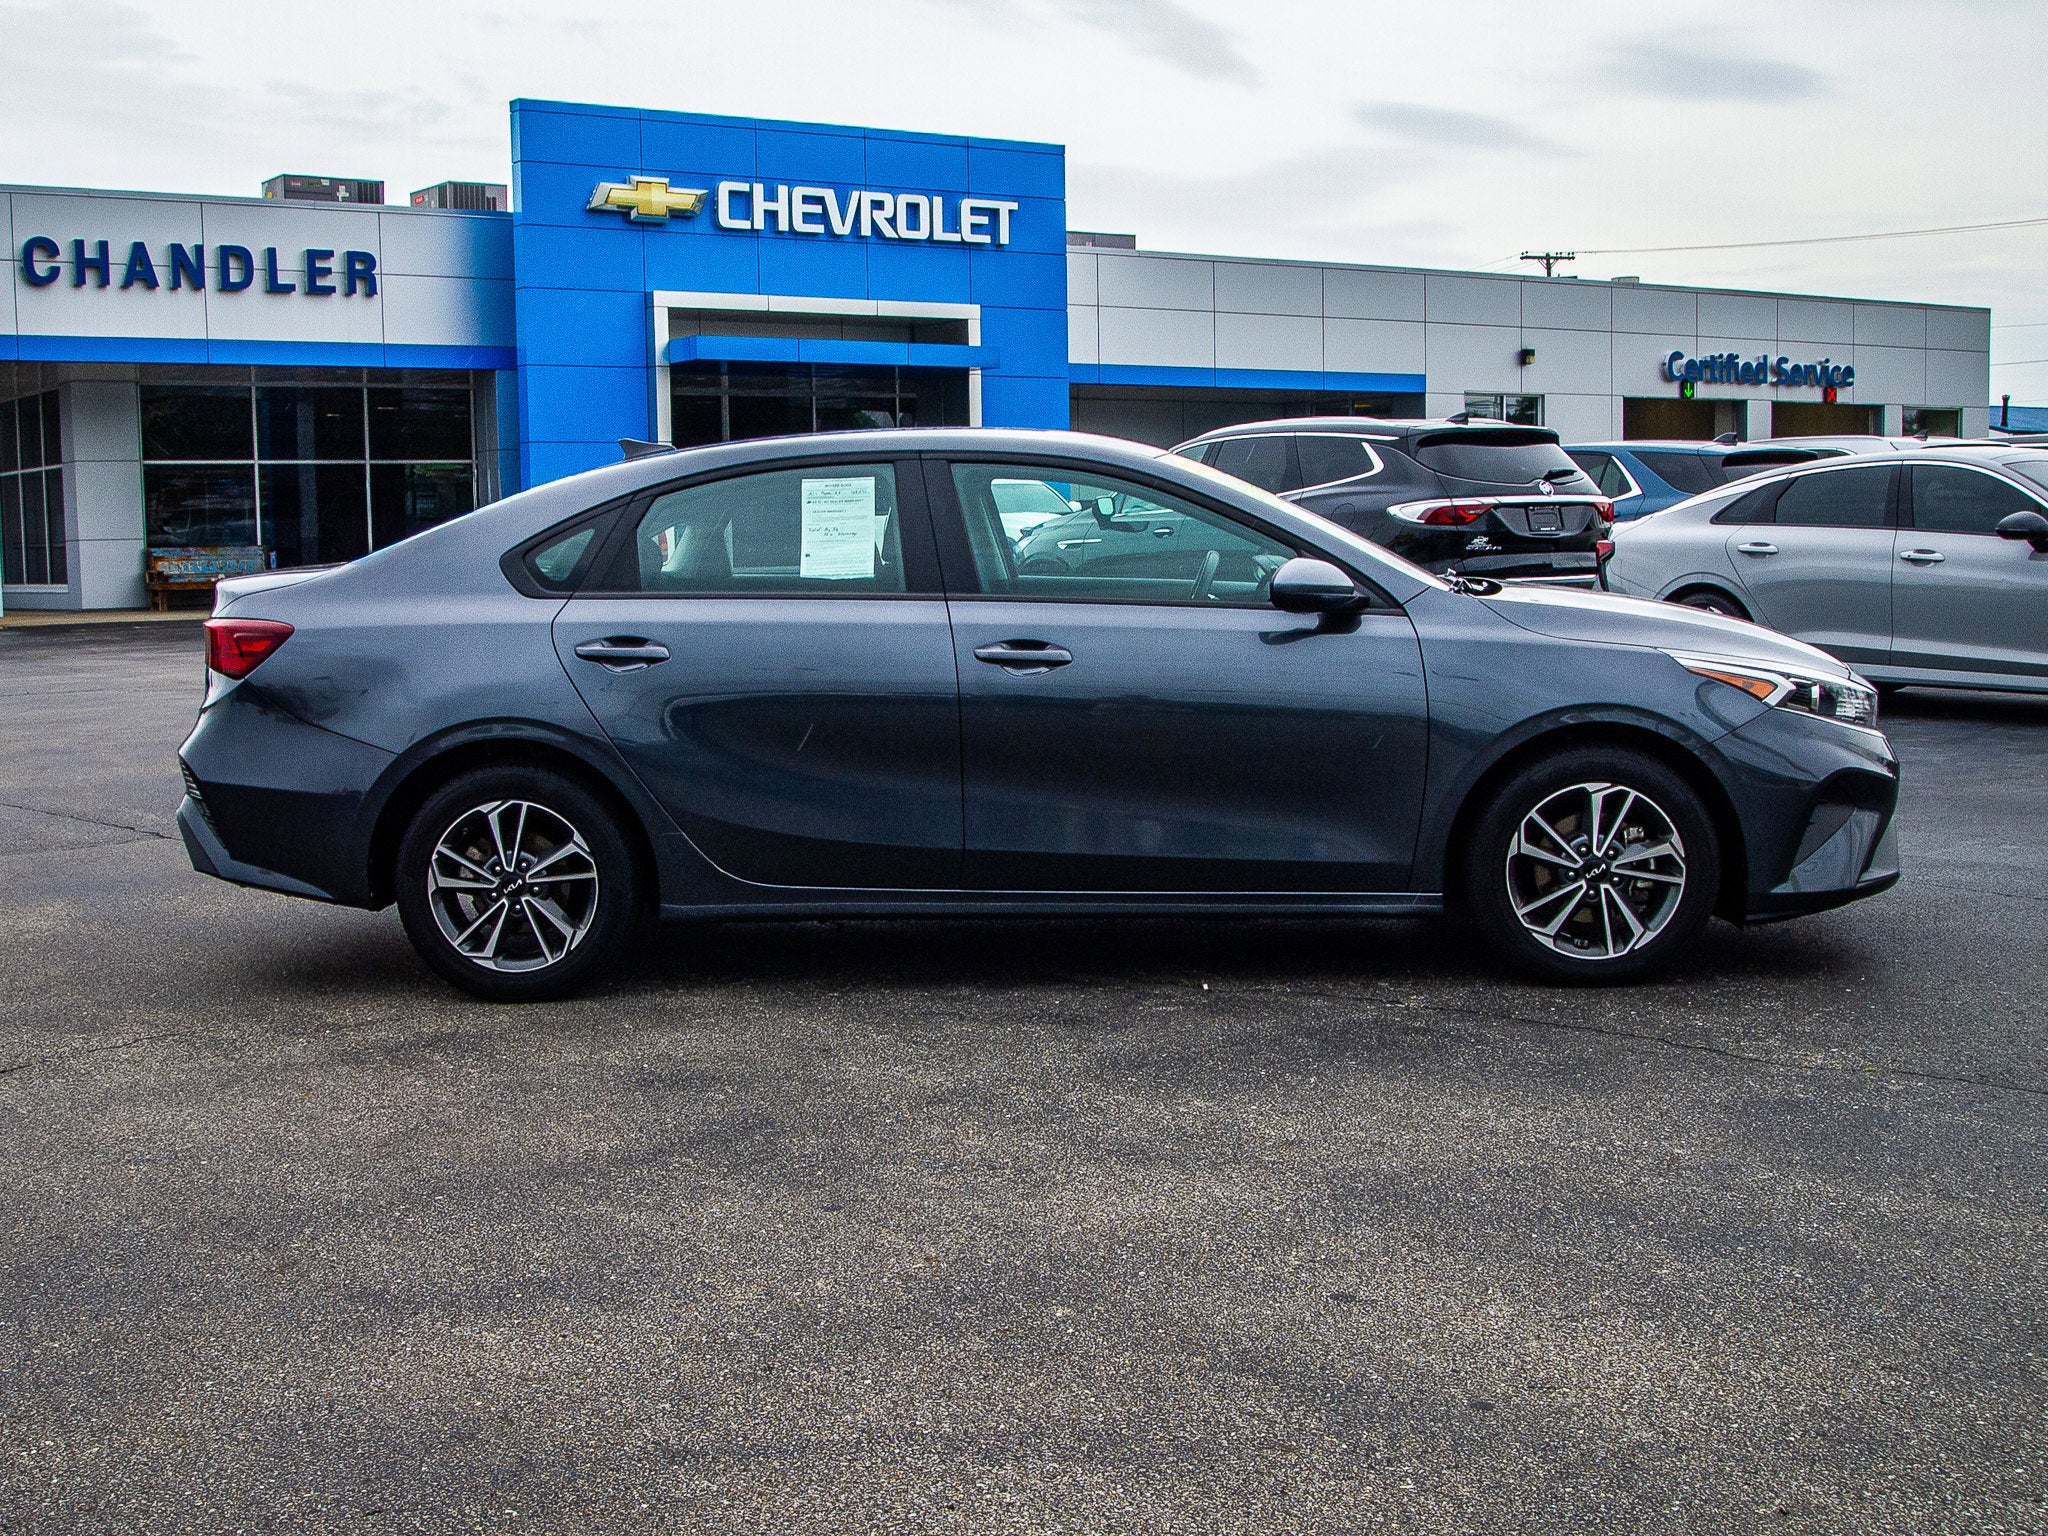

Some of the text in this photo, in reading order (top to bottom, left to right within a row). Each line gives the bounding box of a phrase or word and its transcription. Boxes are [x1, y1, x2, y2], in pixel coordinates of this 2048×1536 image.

[718, 180, 1019, 245] CHEVROLET
[21, 235, 379, 297] CHANDLER
[1667, 350, 1855, 387] Certified Service
